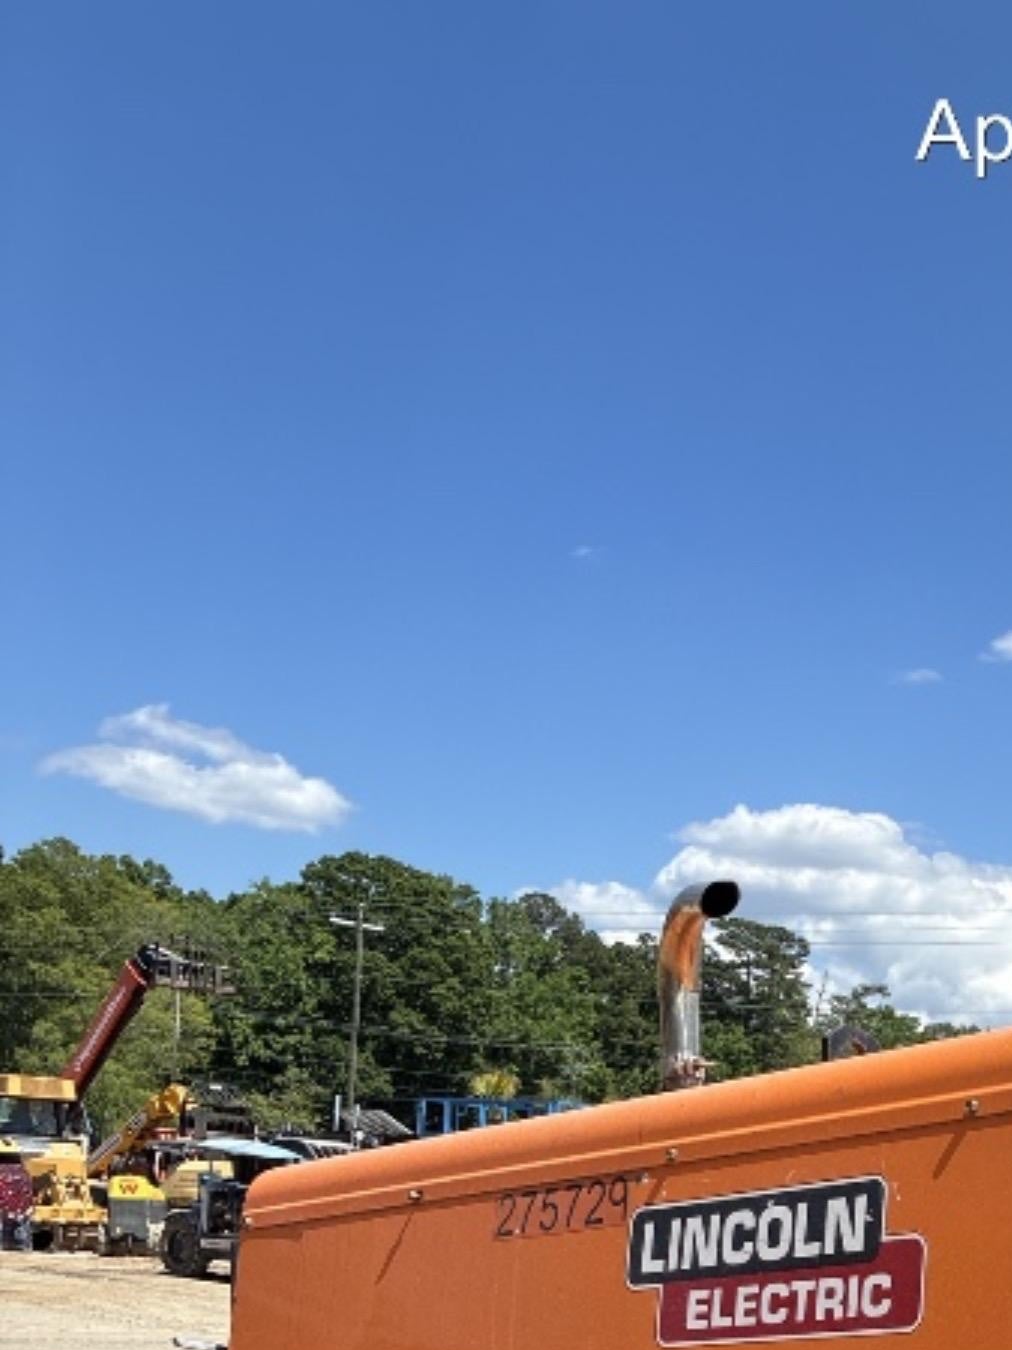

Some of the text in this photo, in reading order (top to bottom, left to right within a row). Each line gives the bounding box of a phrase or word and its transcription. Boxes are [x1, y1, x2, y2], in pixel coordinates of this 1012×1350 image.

[498, 1176, 628, 1237] 275729
[641, 1194, 869, 1273] LINCOLN
[686, 1273, 892, 1330] ELECTRIC
